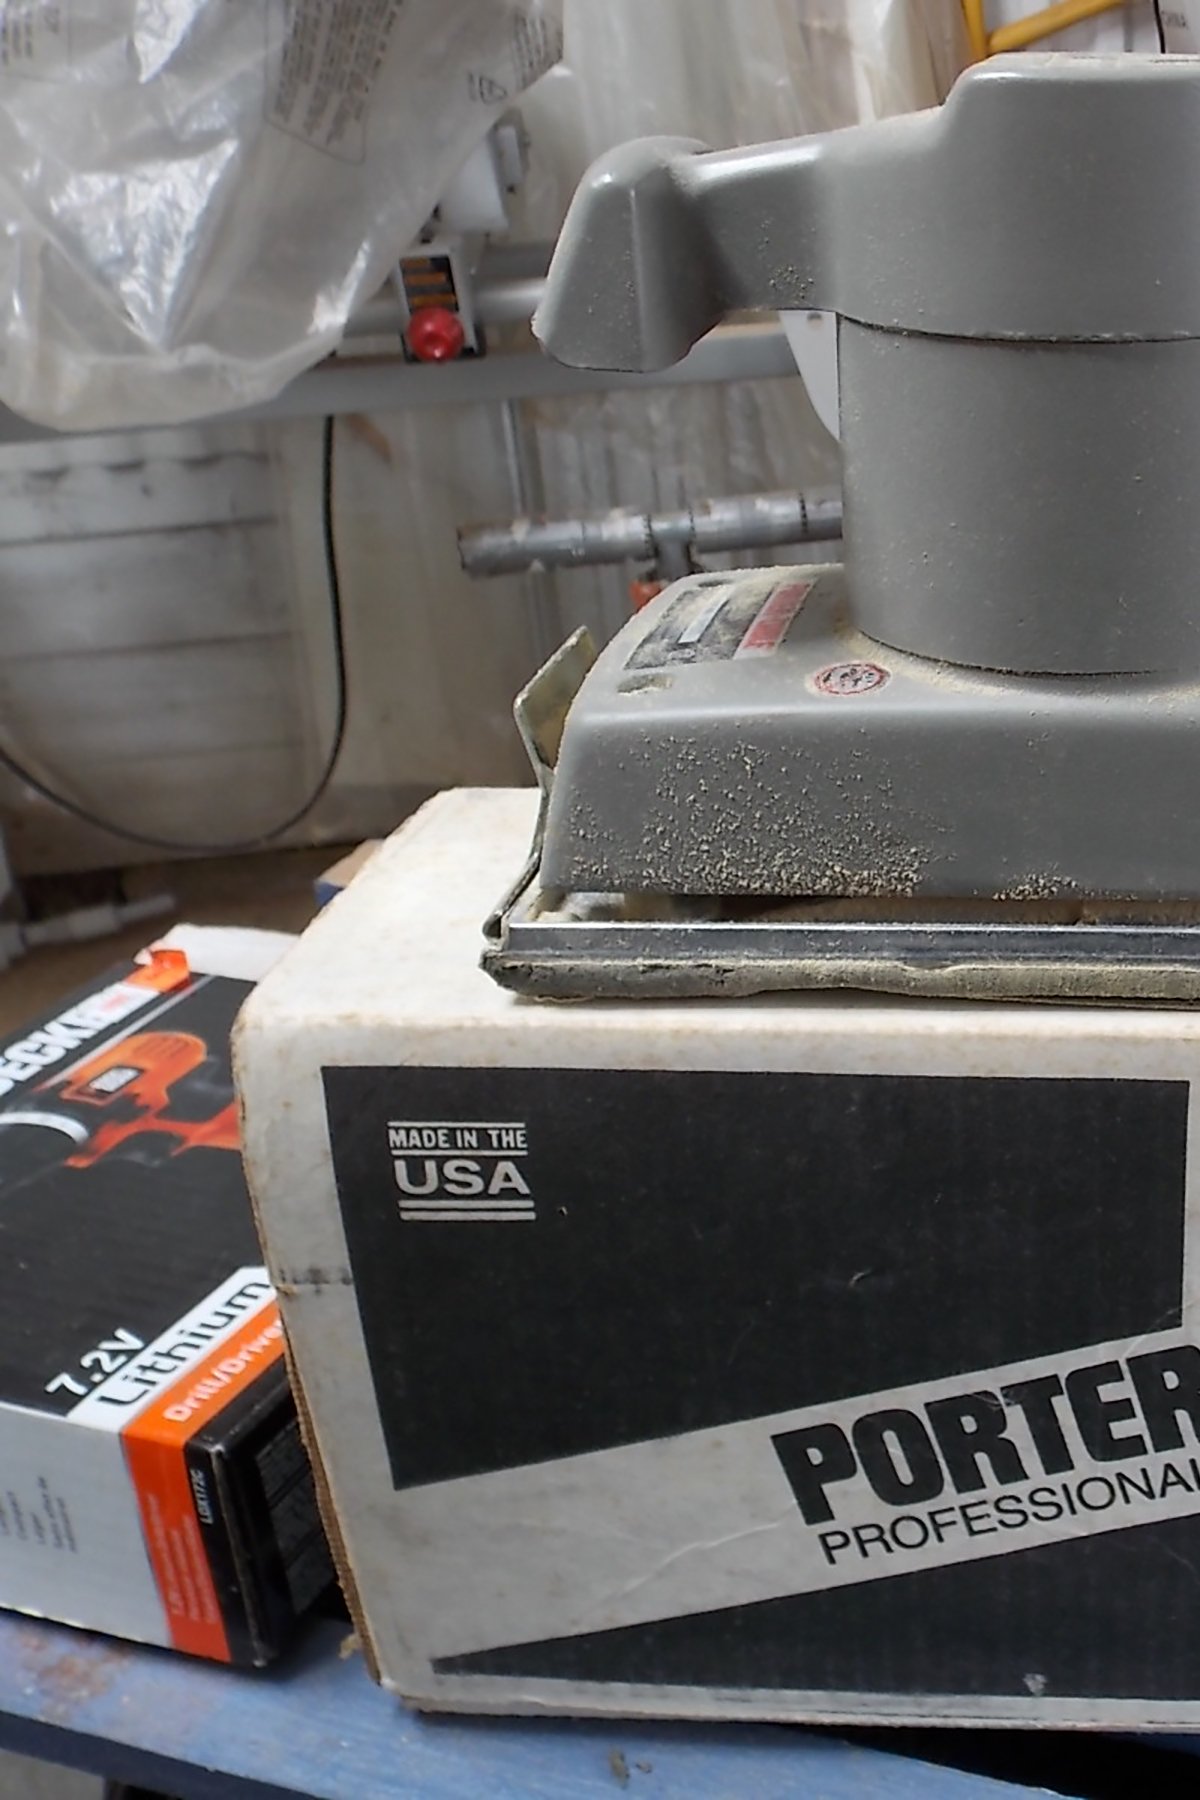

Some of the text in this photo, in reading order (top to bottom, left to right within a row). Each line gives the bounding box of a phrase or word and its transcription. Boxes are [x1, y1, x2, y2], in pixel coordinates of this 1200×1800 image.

[388, 1128, 528, 1148] MADE IN THE
[394, 1159, 531, 1195] USA
[44, 1327, 146, 1396] 7.2V
[98, 1281, 271, 1407] Lithium
[163, 1316, 284, 1423] Drill/Drive
